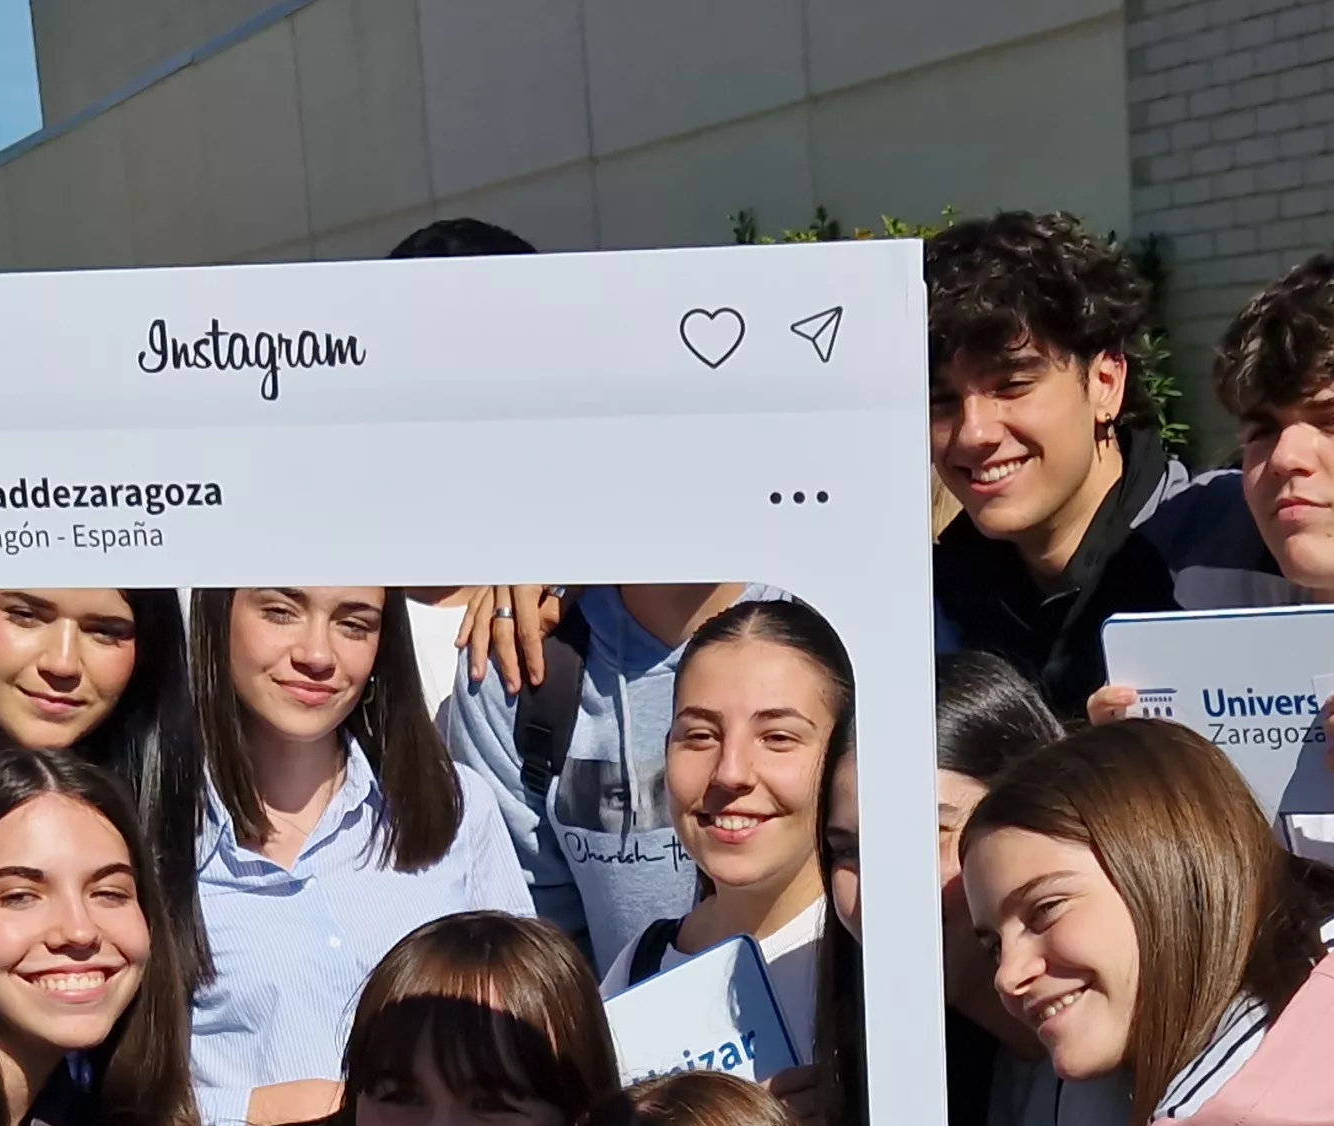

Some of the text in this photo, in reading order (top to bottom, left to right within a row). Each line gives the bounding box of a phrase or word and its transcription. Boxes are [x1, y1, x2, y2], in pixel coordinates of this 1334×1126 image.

[138, 318, 366, 401] Instagram
[73, 521, 164, 554] España
[1208, 723, 1327, 750] Zaragoza
[564, 832, 664, 864] Cherish
